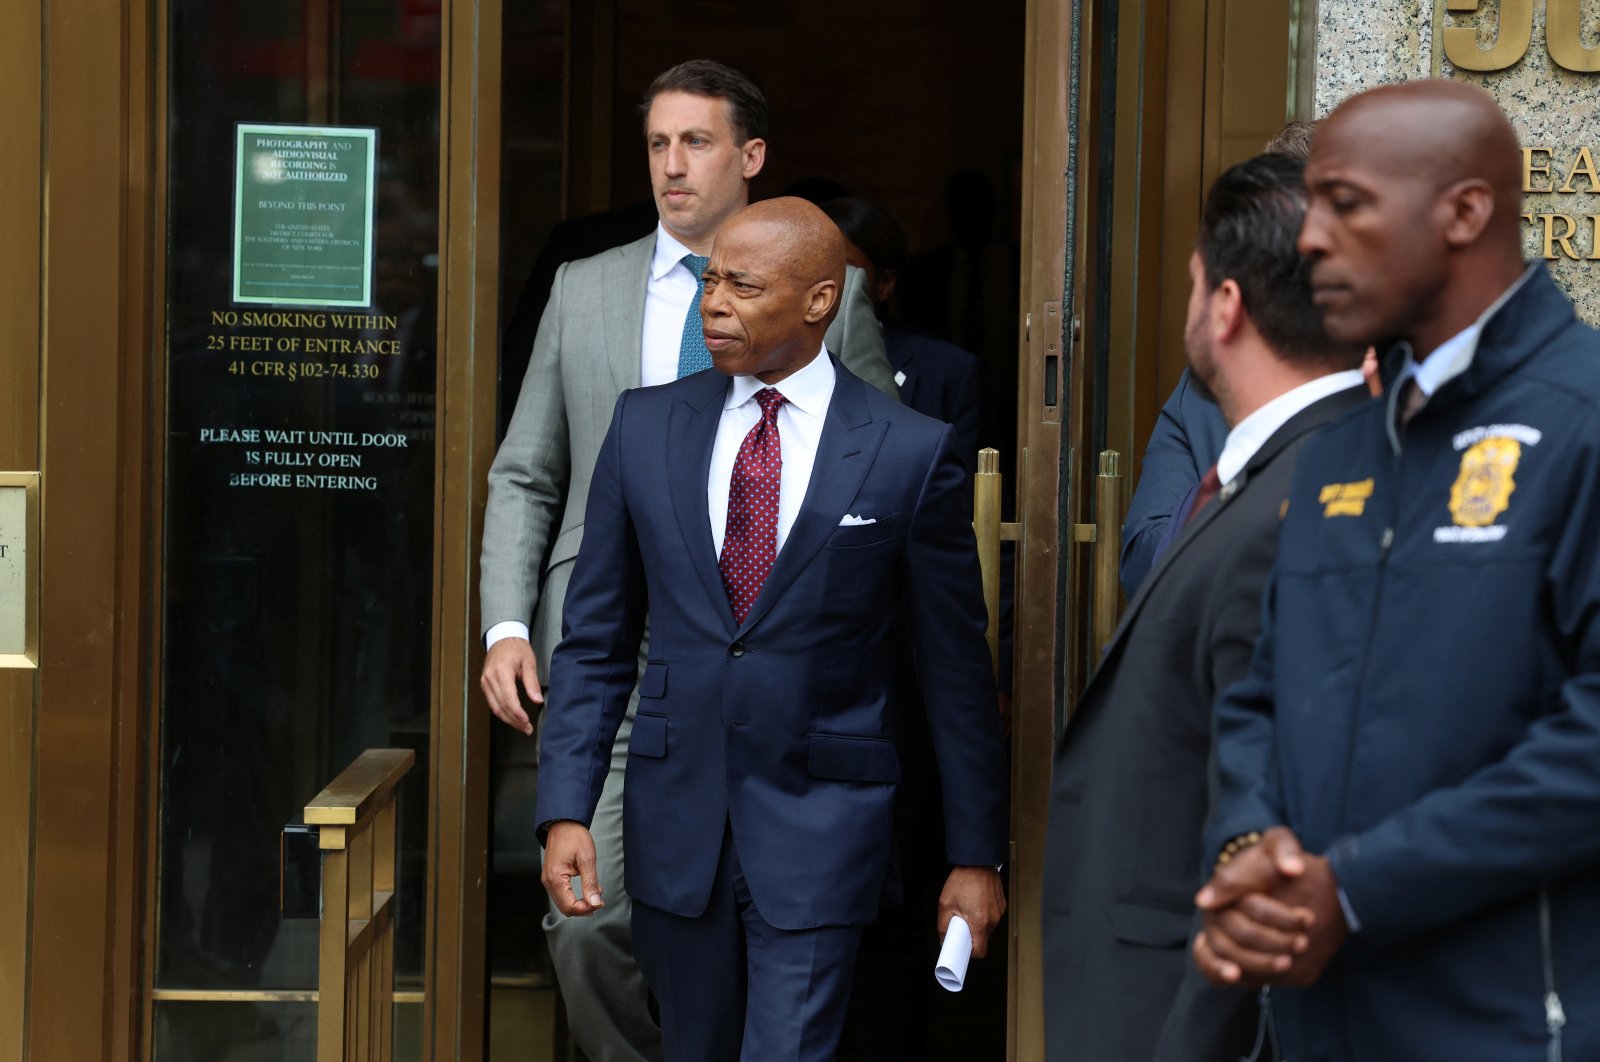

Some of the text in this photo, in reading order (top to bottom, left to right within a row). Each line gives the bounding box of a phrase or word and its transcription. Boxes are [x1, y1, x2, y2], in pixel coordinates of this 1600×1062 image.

[256, 138, 352, 150] PHOTOGRAPHY AND
[272, 150, 339, 160] AUDIO/VISUAL
[270, 160, 337, 170] RECORDING IS
[262, 169, 348, 181] NOT AUTHORIZED
[258, 200, 347, 211] BEYOND THIS POINT
[211, 311, 398, 330] NO SMOKING WITHIN
[206, 335, 401, 355] 25 FEET OF ENTRANCE
[228, 360, 245, 375] 41
[200, 428, 260, 444] PLEASE
[264, 430, 306, 445] WAIT
[309, 431, 358, 446] UNTIL
[361, 433, 409, 448] DOOR
[246, 451, 362, 468] IS FULLY OPEN
[229, 473, 378, 491] BEFORE ENTERING
